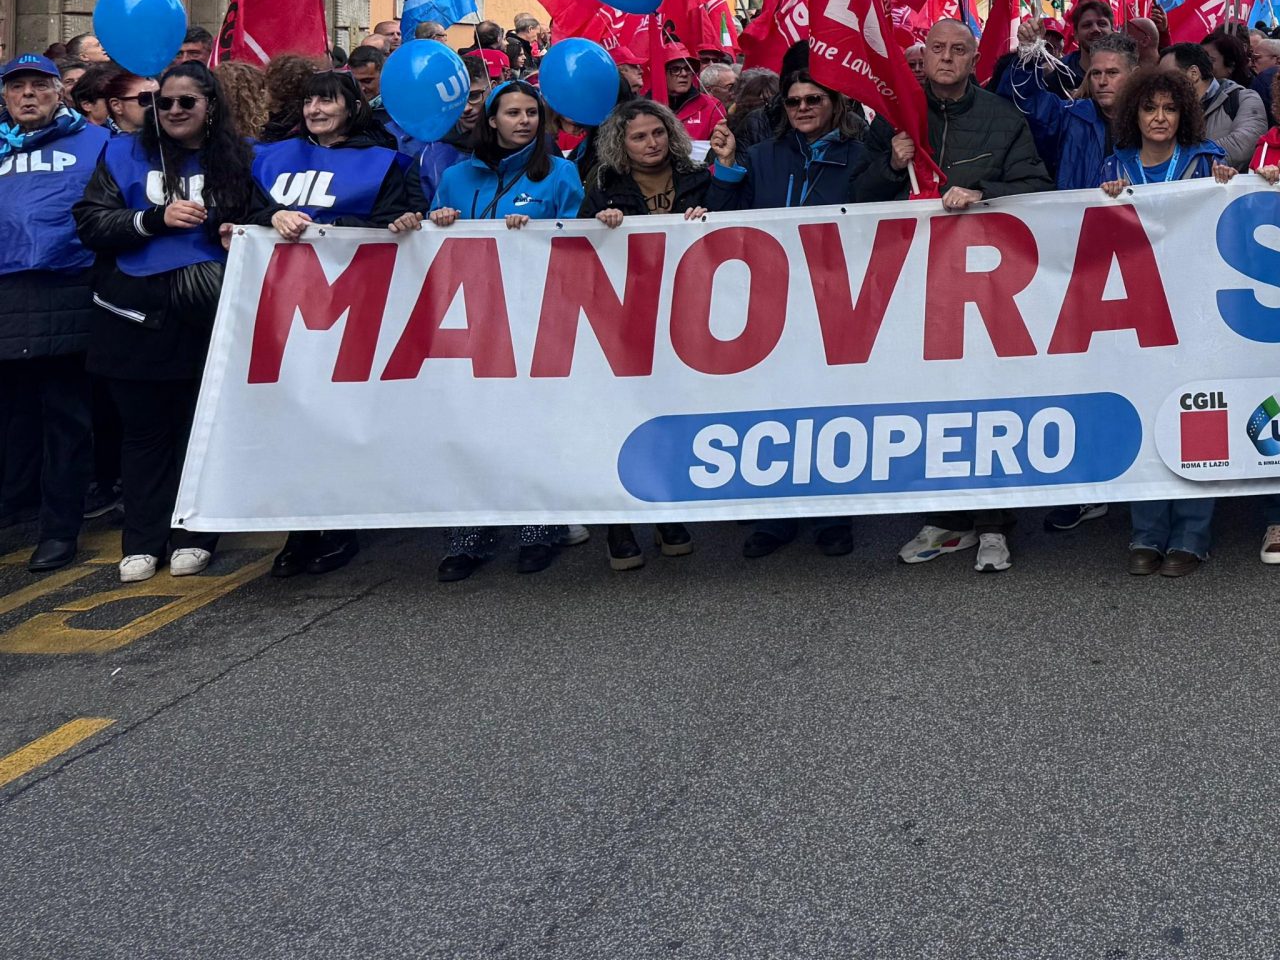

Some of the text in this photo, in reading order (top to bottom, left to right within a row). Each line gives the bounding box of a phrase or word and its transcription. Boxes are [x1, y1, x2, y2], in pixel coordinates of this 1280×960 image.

[18, 55, 41, 64] UIL
[269, 170, 337, 208] UIL
[249, 204, 1178, 384] MANOVRA
[1180, 391, 1227, 410] CGIL
[689, 406, 1076, 488] SCIOPERO
